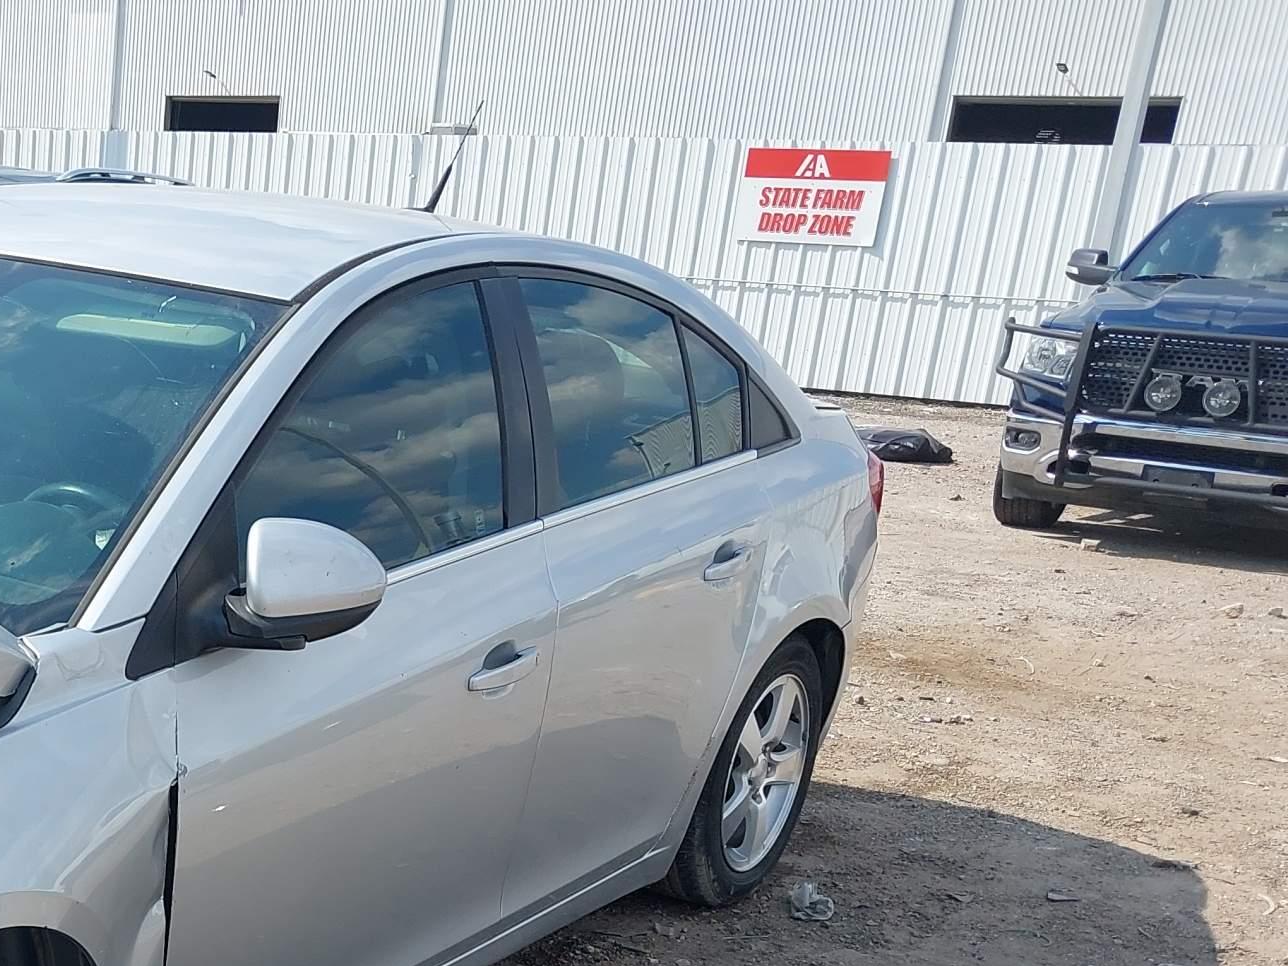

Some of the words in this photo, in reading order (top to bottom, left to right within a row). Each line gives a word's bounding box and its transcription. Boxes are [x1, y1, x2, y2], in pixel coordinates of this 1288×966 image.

[759, 186, 811, 209] STATE
[813, 189, 865, 211] FARM
[757, 212, 808, 234] DROP
[807, 214, 856, 236] ZONE
